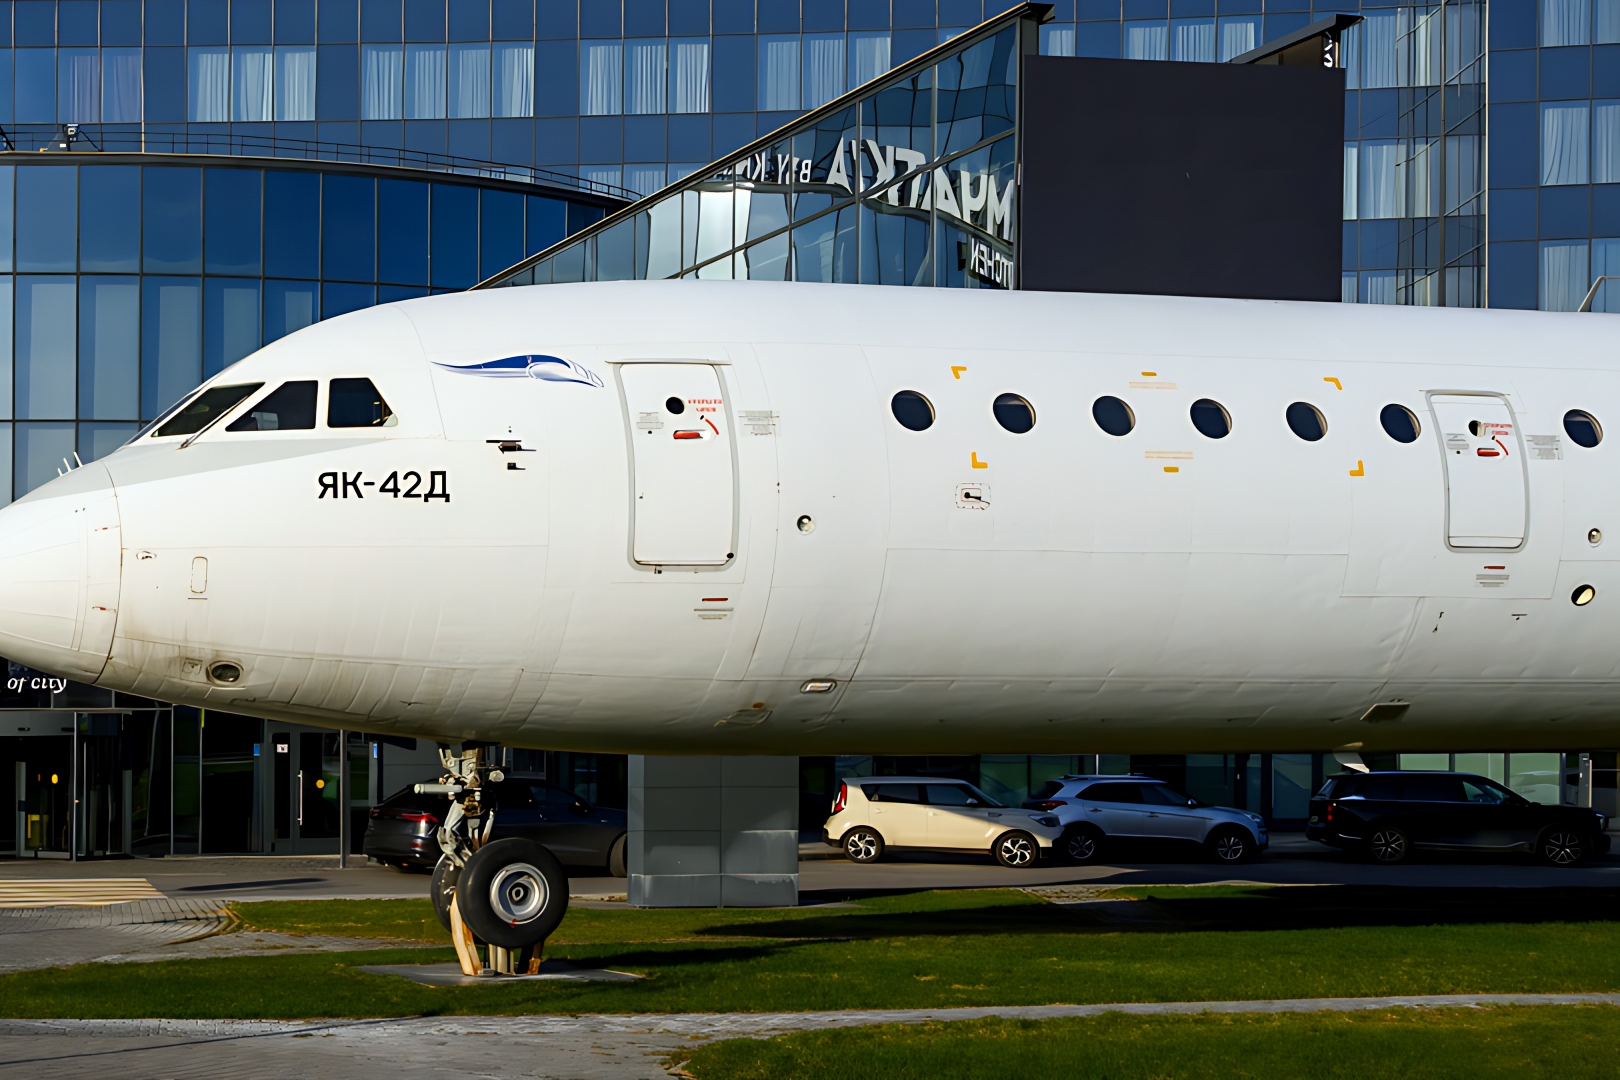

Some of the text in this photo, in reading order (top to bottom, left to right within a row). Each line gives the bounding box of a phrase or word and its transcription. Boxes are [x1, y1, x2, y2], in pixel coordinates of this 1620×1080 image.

[317, 470, 451, 503] ЯК-42Д
[6, 676, 27, 693] of
[30, 676, 67, 693] city
